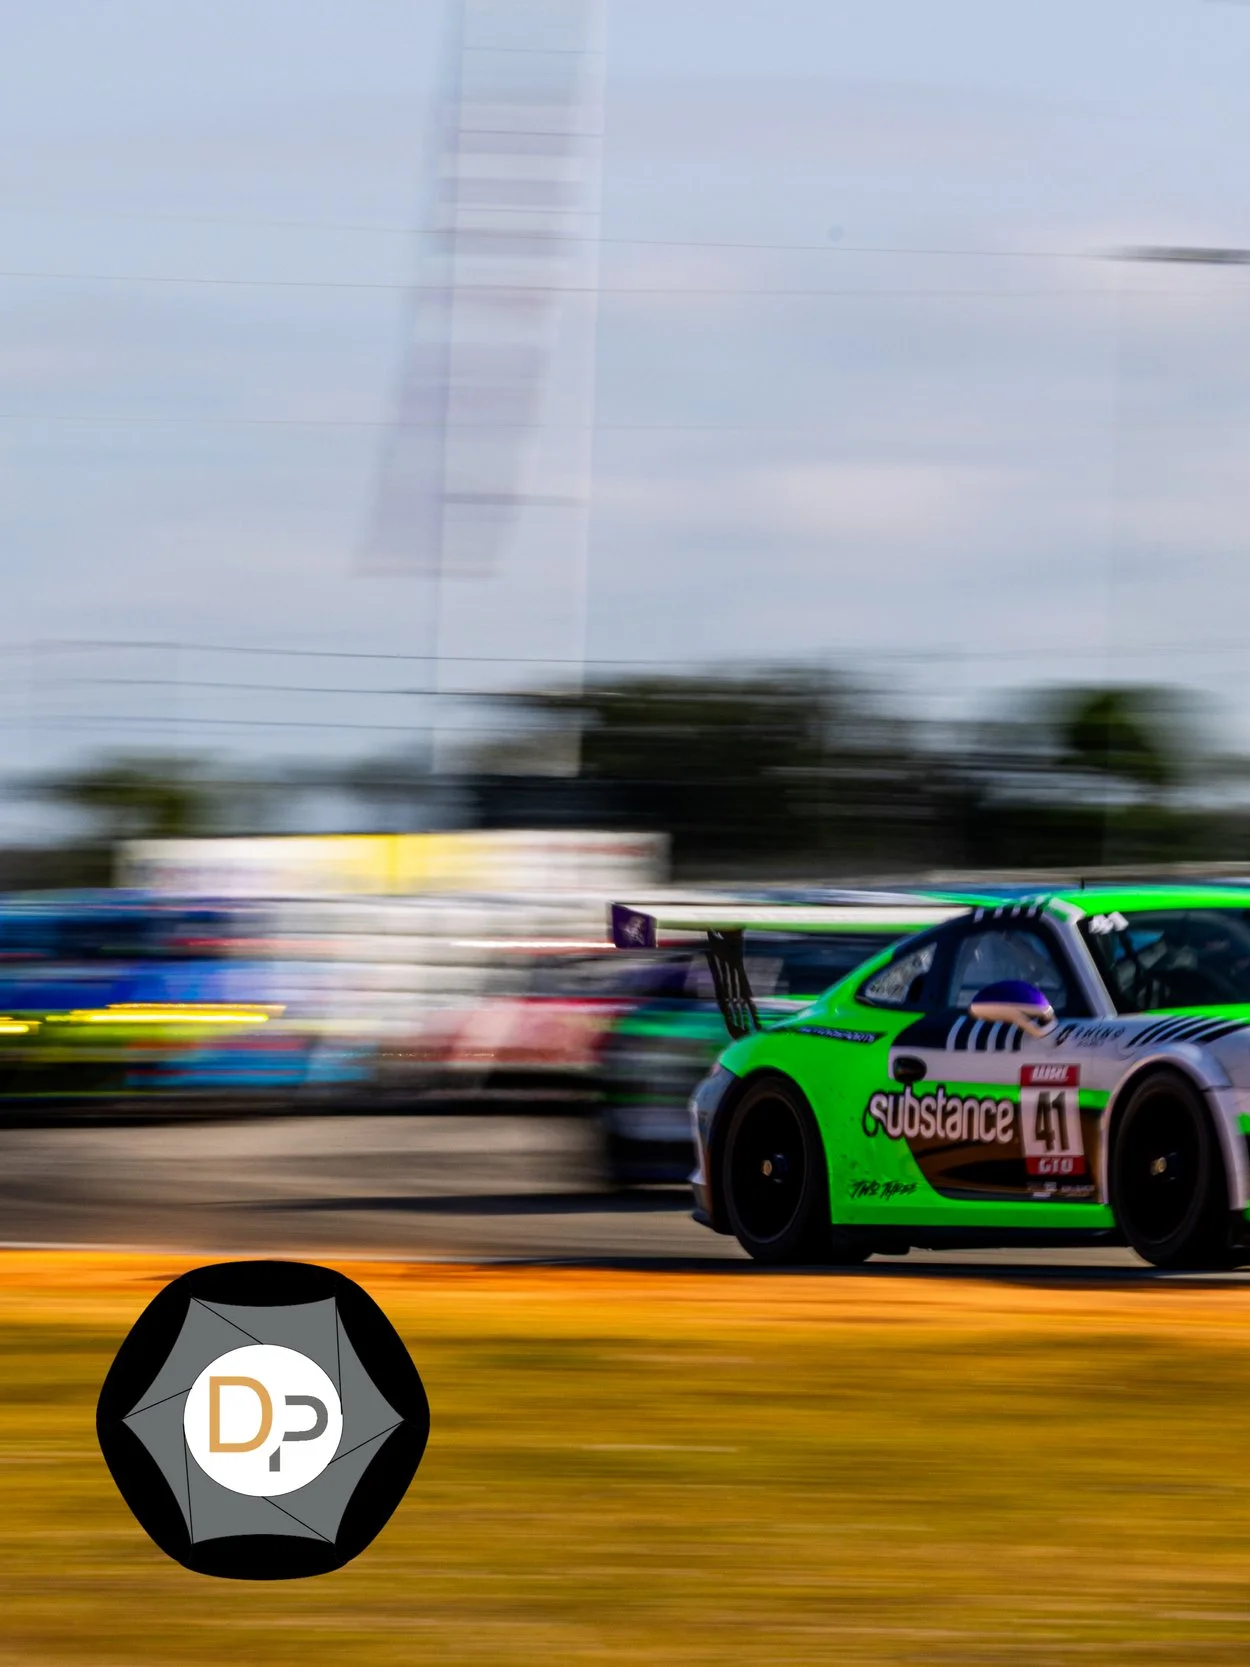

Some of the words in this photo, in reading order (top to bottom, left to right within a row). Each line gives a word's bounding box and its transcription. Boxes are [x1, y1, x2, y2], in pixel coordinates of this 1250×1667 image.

[867, 1086, 1015, 1144] substance
[1034, 1090, 1071, 1153] 41
[1037, 1157, 1074, 1175] GTO
